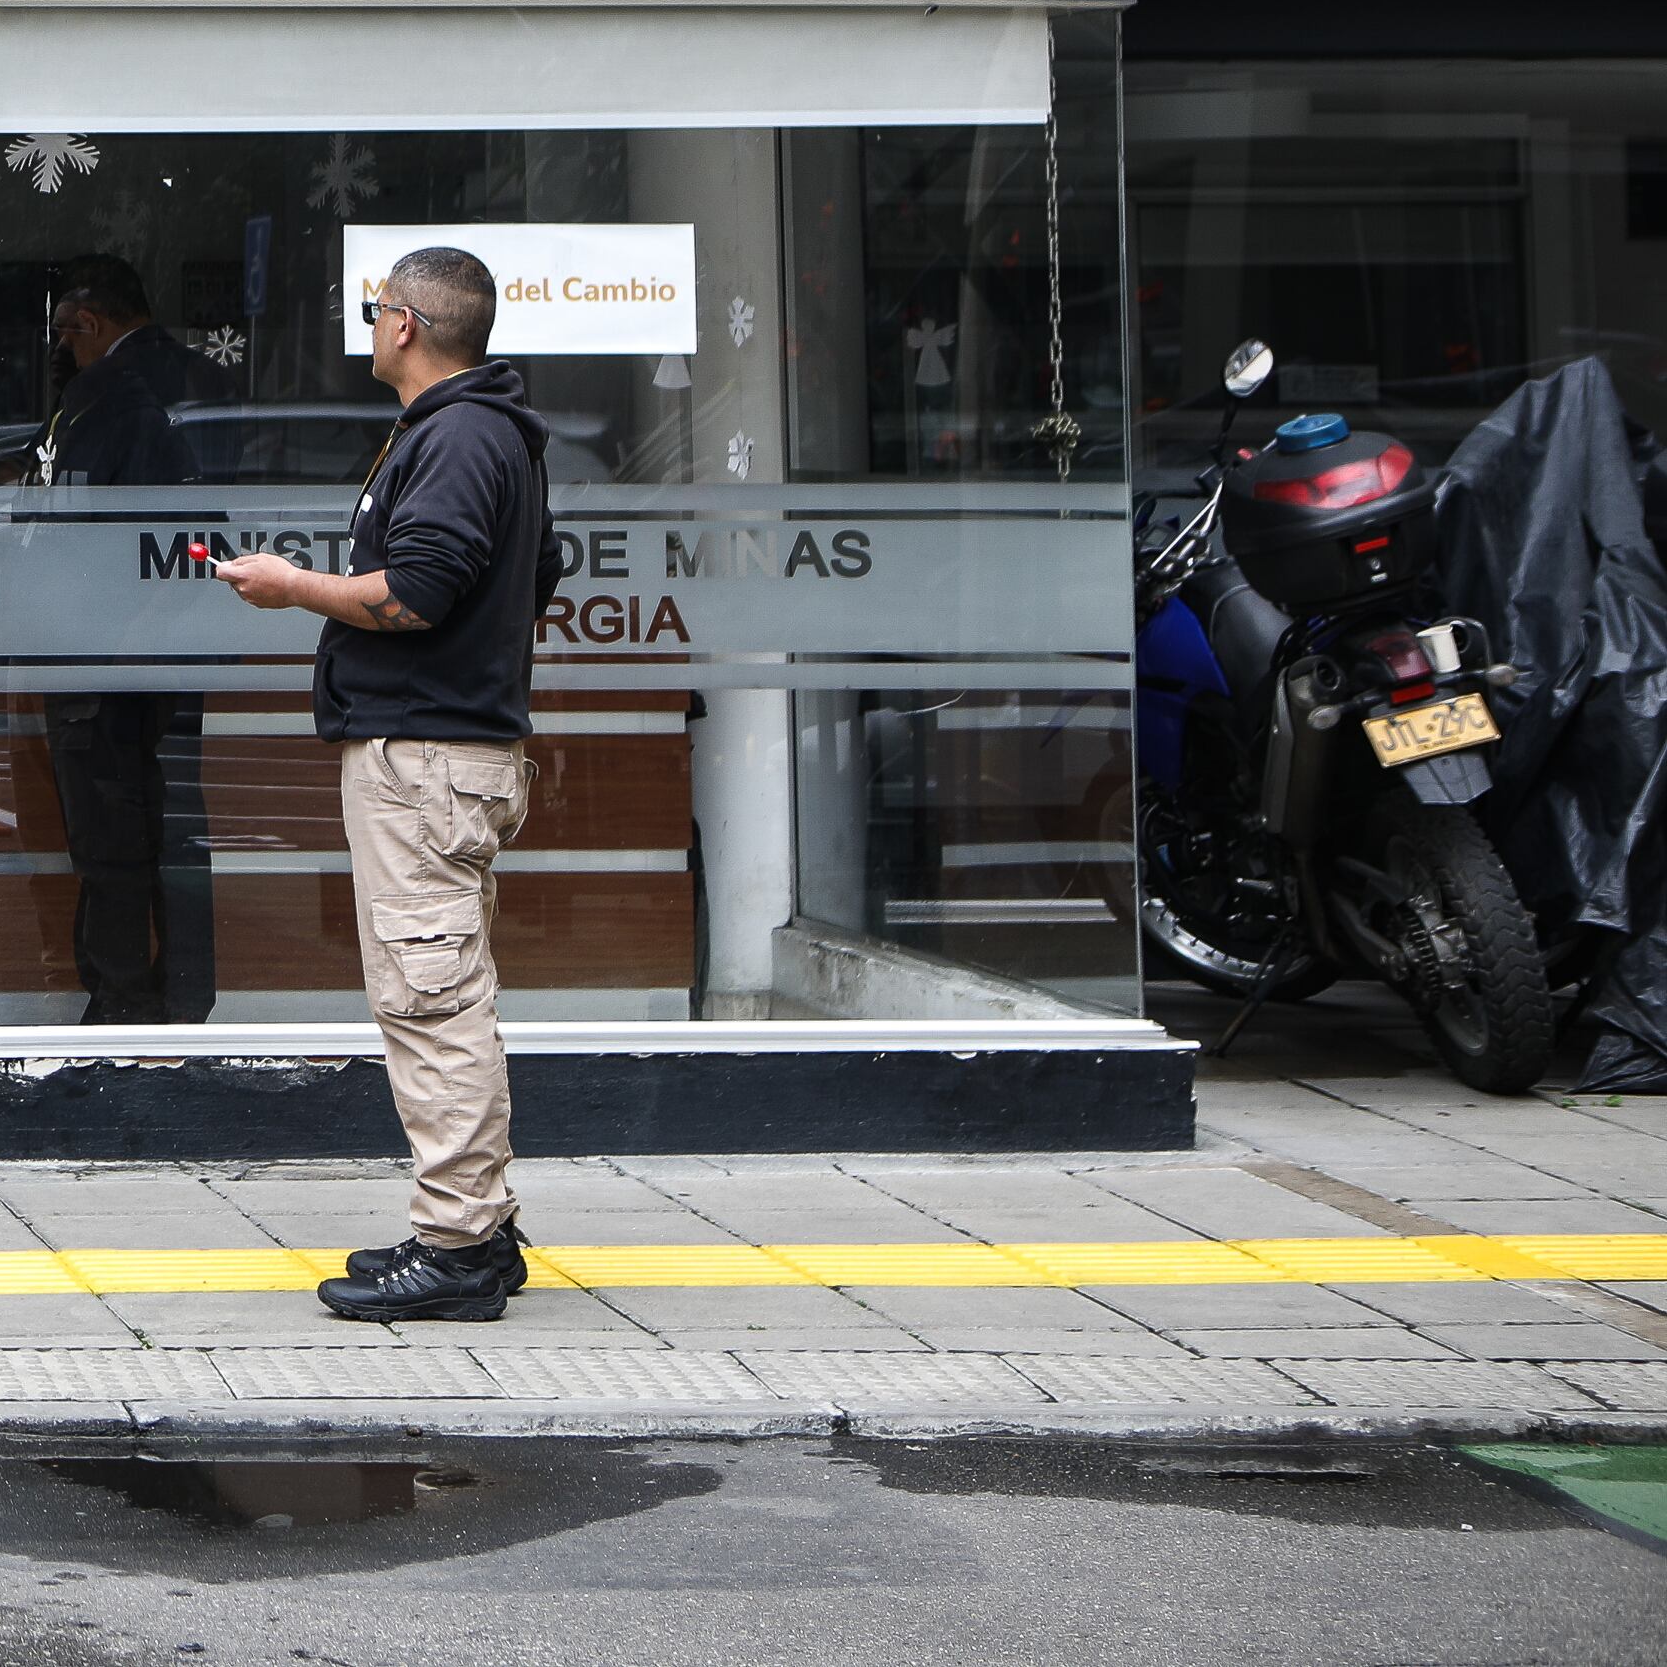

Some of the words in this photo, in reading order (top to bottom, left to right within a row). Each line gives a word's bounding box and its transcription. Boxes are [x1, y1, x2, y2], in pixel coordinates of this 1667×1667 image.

[505, 277, 553, 302] del
[562, 276, 677, 303] Cambio
[554, 530, 630, 579] DE
[665, 528, 873, 580] MINAS
[536, 594, 691, 644] RGIA
